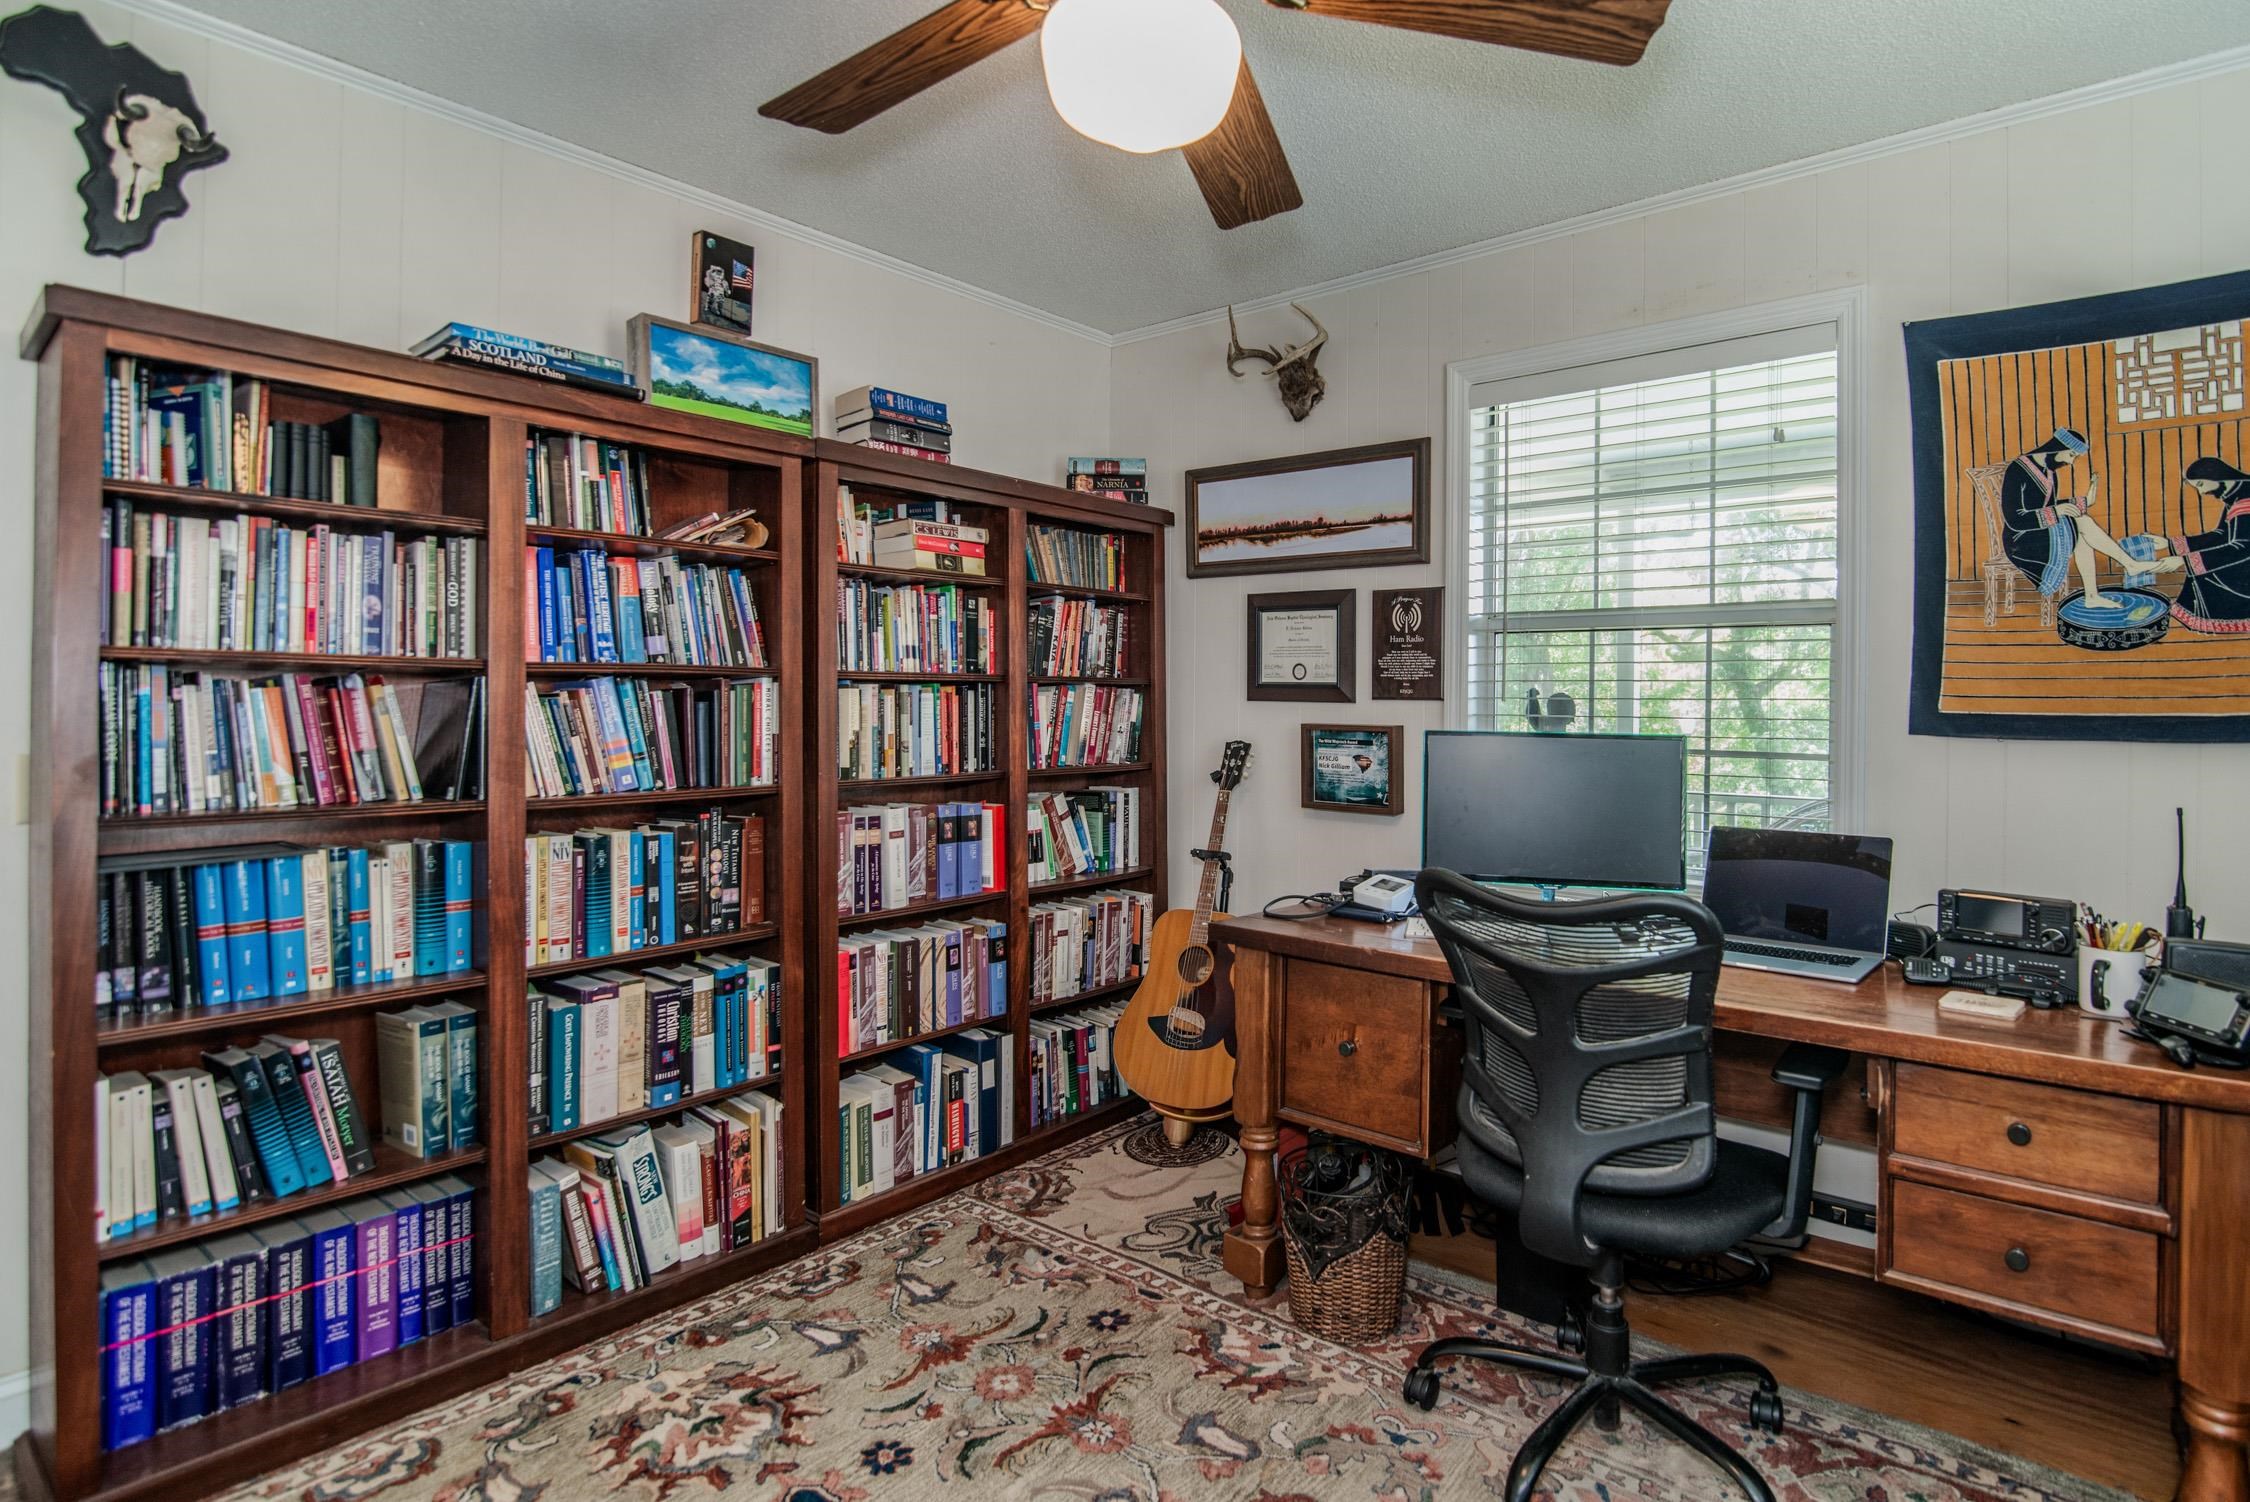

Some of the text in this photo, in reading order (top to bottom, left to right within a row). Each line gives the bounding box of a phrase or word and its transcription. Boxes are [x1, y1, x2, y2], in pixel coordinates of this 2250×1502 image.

[474, 328, 494, 341] The
[452, 347, 460, 355] A
[461, 349, 480, 362] Day
[483, 352, 492, 362] in
[494, 356, 509, 366] the
[510, 360, 528, 372] Life
[529, 364, 538, 373] of
[539, 367, 565, 380] China
[469, 340, 546, 366] SCOTLAND
[933, 528, 958, 537] LEWIS
[448, 582, 458, 607] GOD
[544, 580, 552, 596] STORY
[597, 556, 611, 633] THE BAPTIST HERITAGE
[644, 567, 658, 613] Missiology
[545, 597, 552, 605] OF
[726, 596, 737, 629] Handbook
[545, 607, 553, 646] CHRISTIANITY
[1406, 635, 1424, 643] Radio
[1050, 635, 1058, 662] KATA
[1085, 687, 1093, 719] DEVOTION
[553, 847, 570, 860] NIV
[722, 839, 730, 874] THEOLOGY
[731, 829, 739, 884] NEW TESTAMENT
[551, 861, 571, 937] APPLICATION COMMENTARY
[617, 854, 628, 926] APPLICATION COMMENTARY
[154, 886, 162, 933] HANDBOOK
[178, 881, 187, 927] GENESIS
[391, 872, 411, 951] APPLICATION COMMENTARY
[144, 881, 155, 958] HISTORICAL BOOKS
[306, 881, 329, 966] APPLICATION COMMENTARY
[657, 1004, 666, 1043] THEOLOGY
[666, 1001, 680, 1042] Christian
[699, 1011, 707, 1033] NEW
[434, 1056, 442, 1071] BOOK
[463, 1049, 471, 1064] BOOK
[564, 1033, 573, 1073] EMPOWERING
[463, 1074, 472, 1094] ISAIAH
[564, 1073, 573, 1101] PRESENCE
[655, 1069, 680, 1080] ERICKSON
[320, 1053, 355, 1146] ISAIAH Motyer
[435, 1081, 443, 1101] ISAIAH
[951, 1102, 960, 1148] WASHINGTON
[633, 1156, 657, 1204] STRONG'S
[650, 1169, 658, 1186] NEW
[452, 1203, 460, 1212] OF
[452, 1213, 460, 1224] THE
[706, 1191, 715, 1223] SCRIPTURE
[367, 1228, 377, 1238] OF
[400, 1216, 408, 1226] OF
[400, 1227, 408, 1238] THE
[566, 1190, 594, 1268] BIBLICAL INTERPRETATION
[325, 1239, 335, 1249] OF
[325, 1250, 335, 1262] THE
[367, 1239, 377, 1250] THE
[232, 1265, 243, 1276] OF
[232, 1277, 243, 1290] THE
[119, 1297, 131, 1309] OF
[119, 1310, 131, 1323] THE
